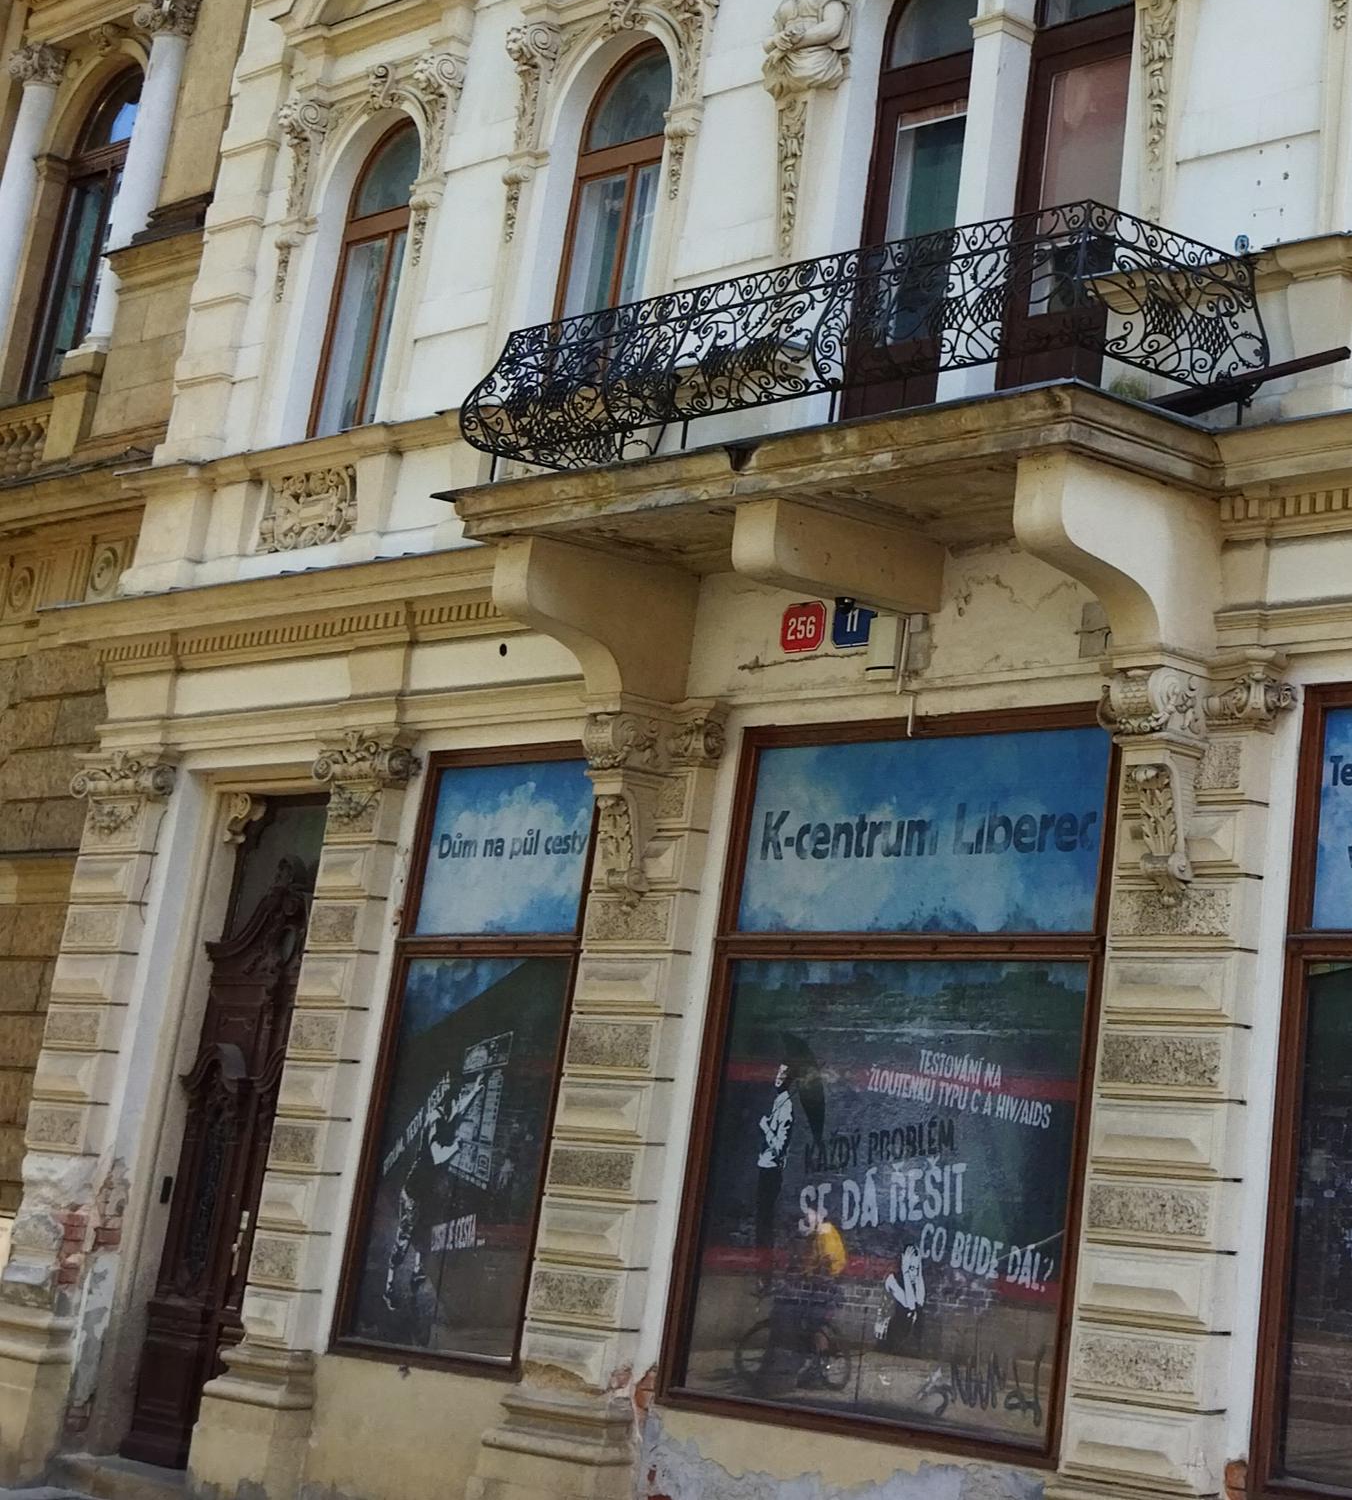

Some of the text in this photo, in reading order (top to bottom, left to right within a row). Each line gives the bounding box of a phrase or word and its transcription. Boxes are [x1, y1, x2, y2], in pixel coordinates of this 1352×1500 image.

[787, 615, 816, 640] 256
[846, 607, 860, 633] 11
[437, 829, 590, 860] Dům na půl cesty
[760, 802, 1098, 861] K-centrum Liberec
[919, 1048, 1003, 1089] TESTOVÁNÍ NA
[866, 1063, 1053, 1130] ŽLOUTENKU TYPU C A HIV/AIDS
[867, 1115, 956, 1165] PROBLÉM
[798, 1155, 968, 1237] SE DÁ ŘEŠIT
[919, 1222, 948, 1263] CO
[950, 1230, 1005, 1280] BUDE
